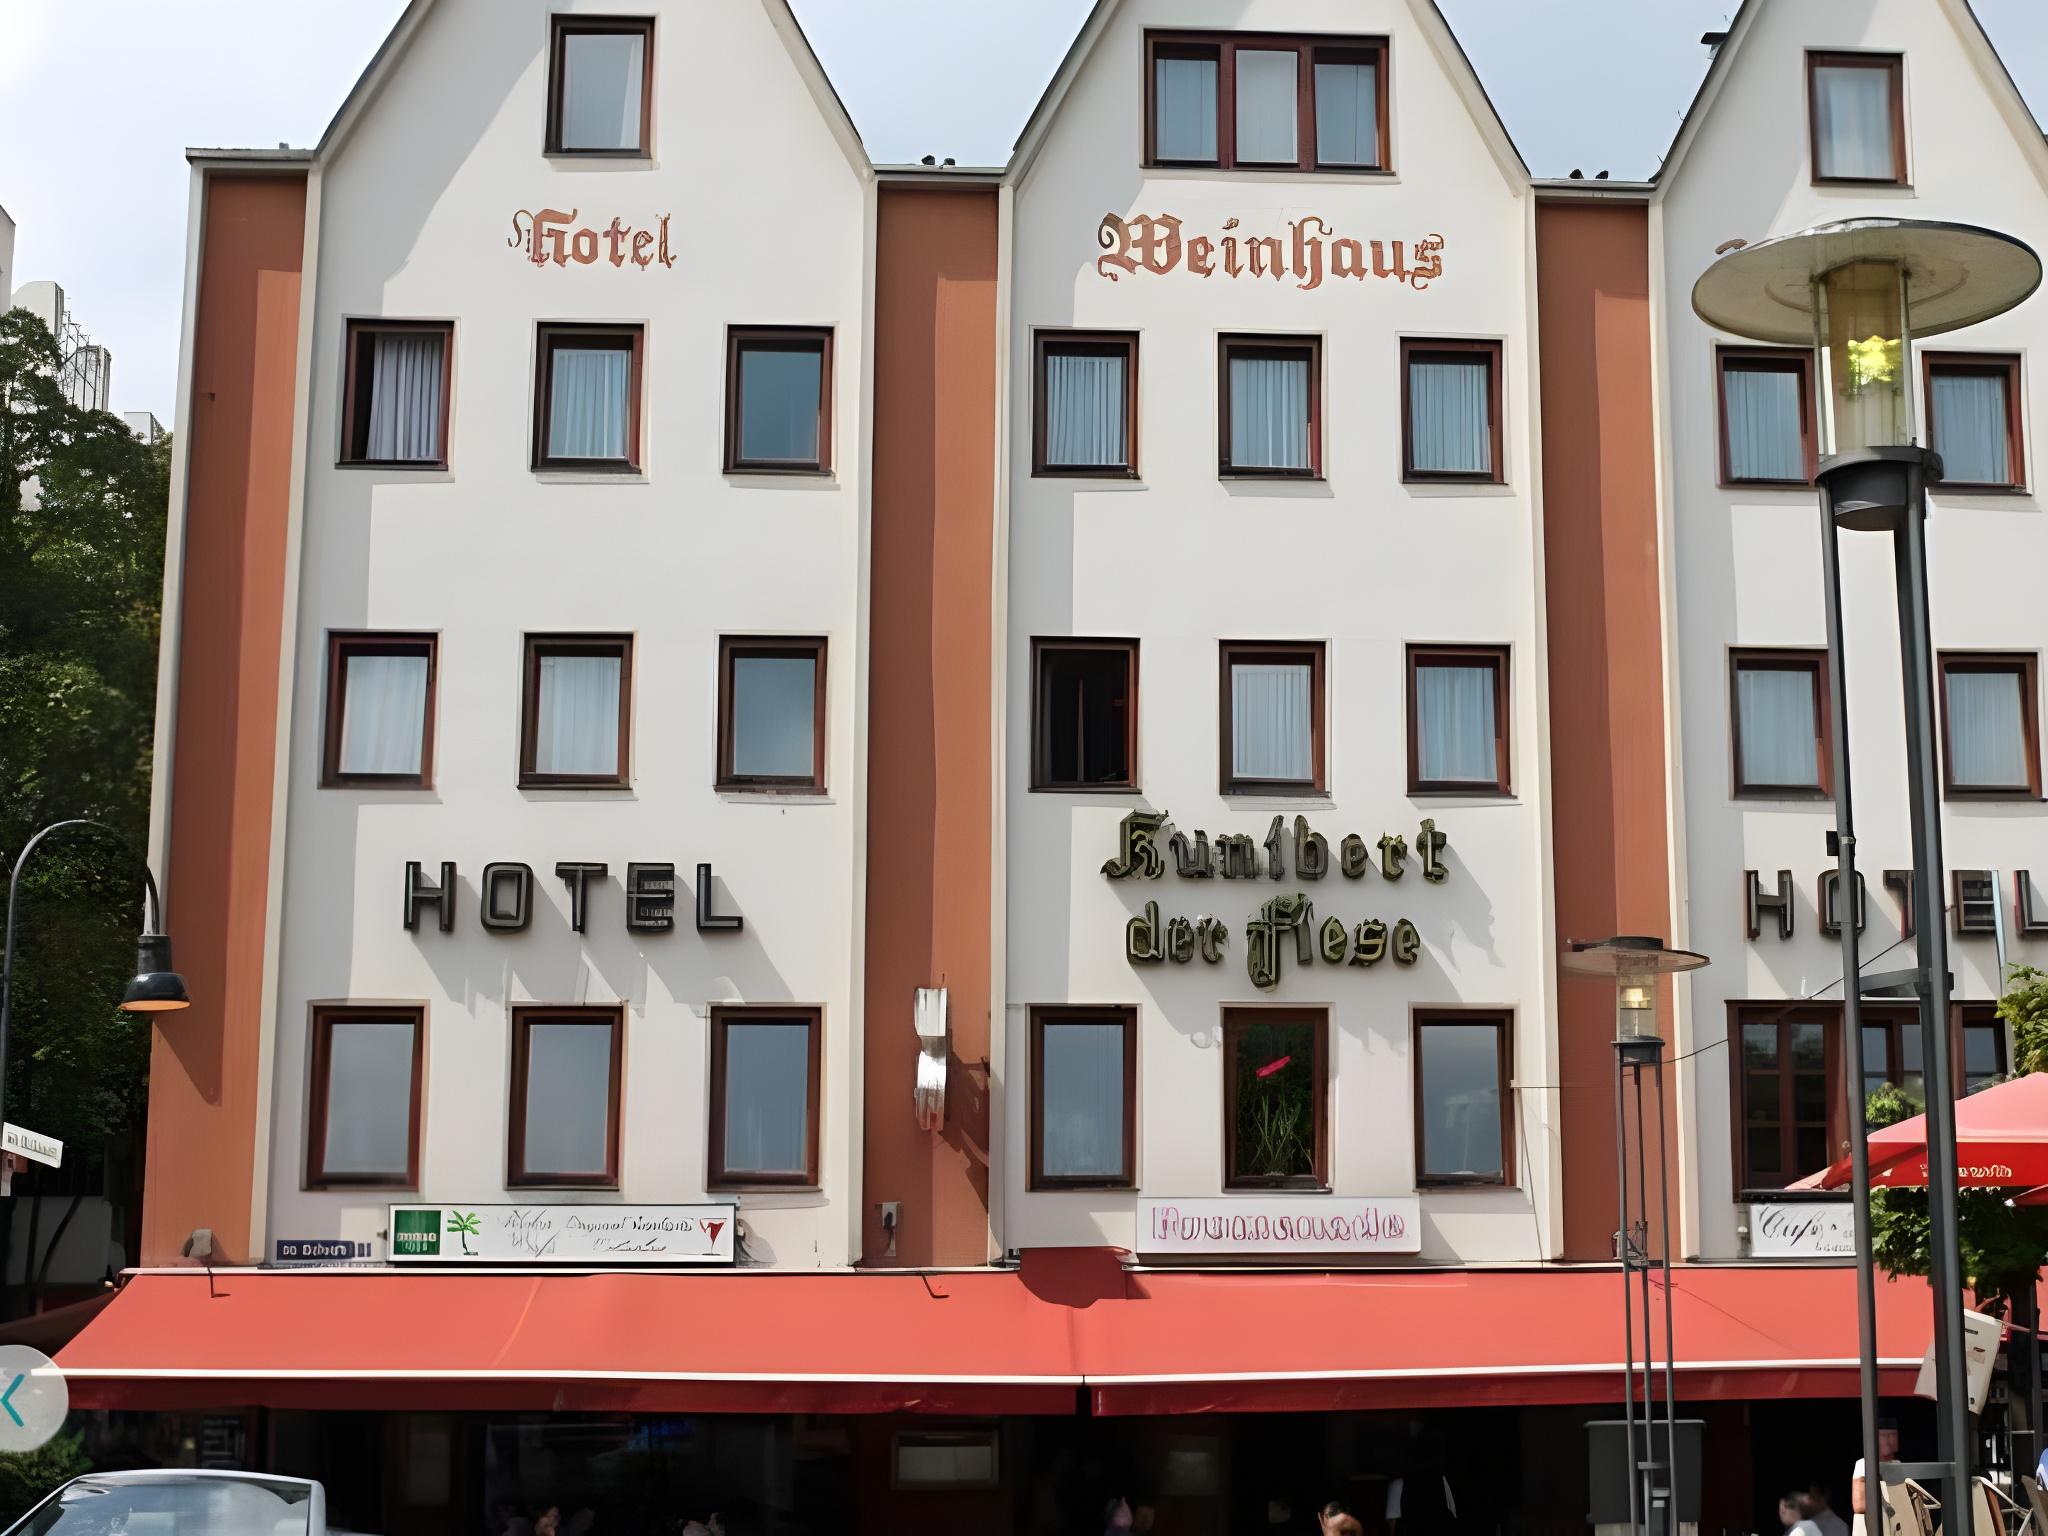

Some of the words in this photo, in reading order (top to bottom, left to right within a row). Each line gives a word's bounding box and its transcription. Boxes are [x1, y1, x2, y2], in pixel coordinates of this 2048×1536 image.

[508, 208, 678, 271] Hotel
[1097, 212, 1445, 290] Weinhaus
[403, 861, 744, 935] HOTEL
